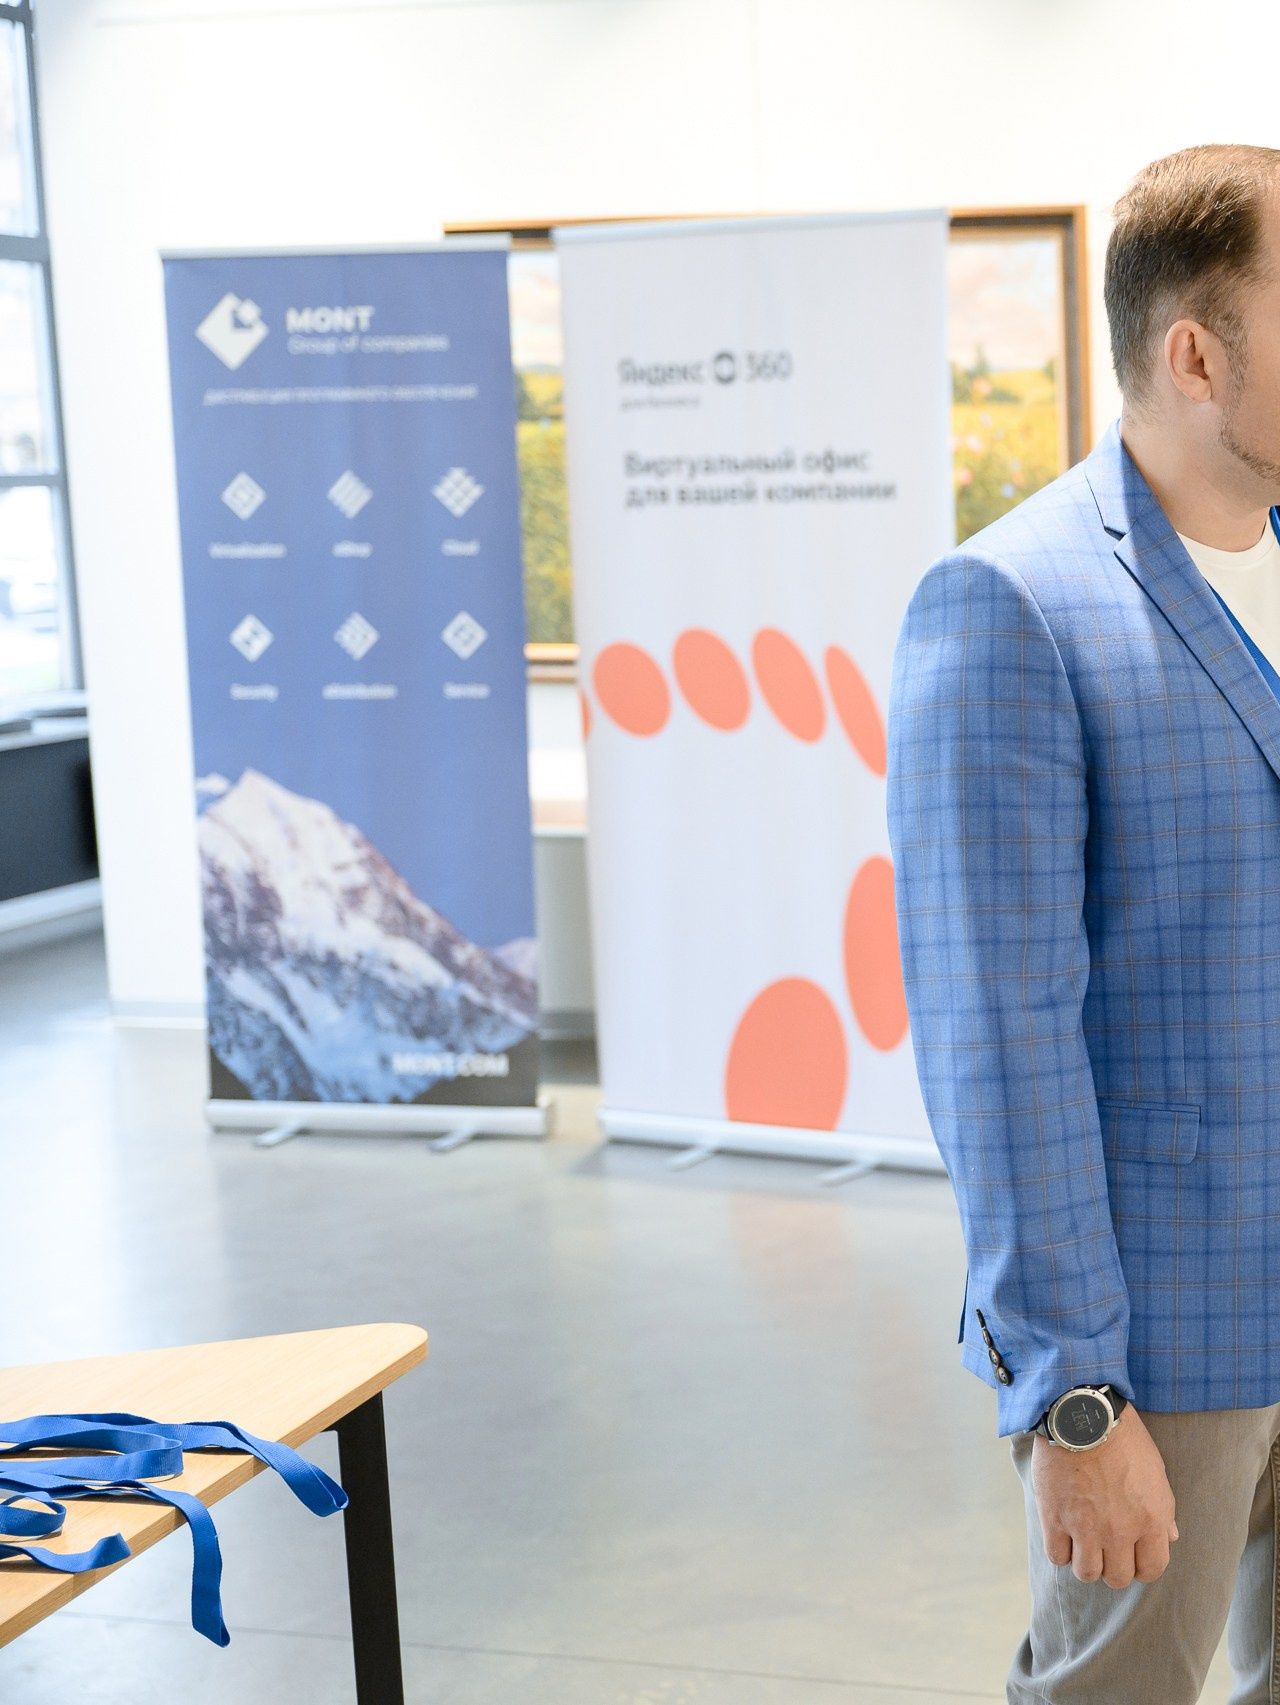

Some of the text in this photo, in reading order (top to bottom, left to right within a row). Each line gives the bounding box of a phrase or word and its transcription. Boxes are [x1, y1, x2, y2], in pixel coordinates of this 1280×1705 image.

[286, 305, 375, 333] MONT
[287, 335, 338, 356] Group
[340, 333, 360, 353] of
[618, 350, 794, 387] Яндекс 360
[625, 446, 871, 479] Виртуальный офис
[626, 477, 897, 508] для вашей компании
